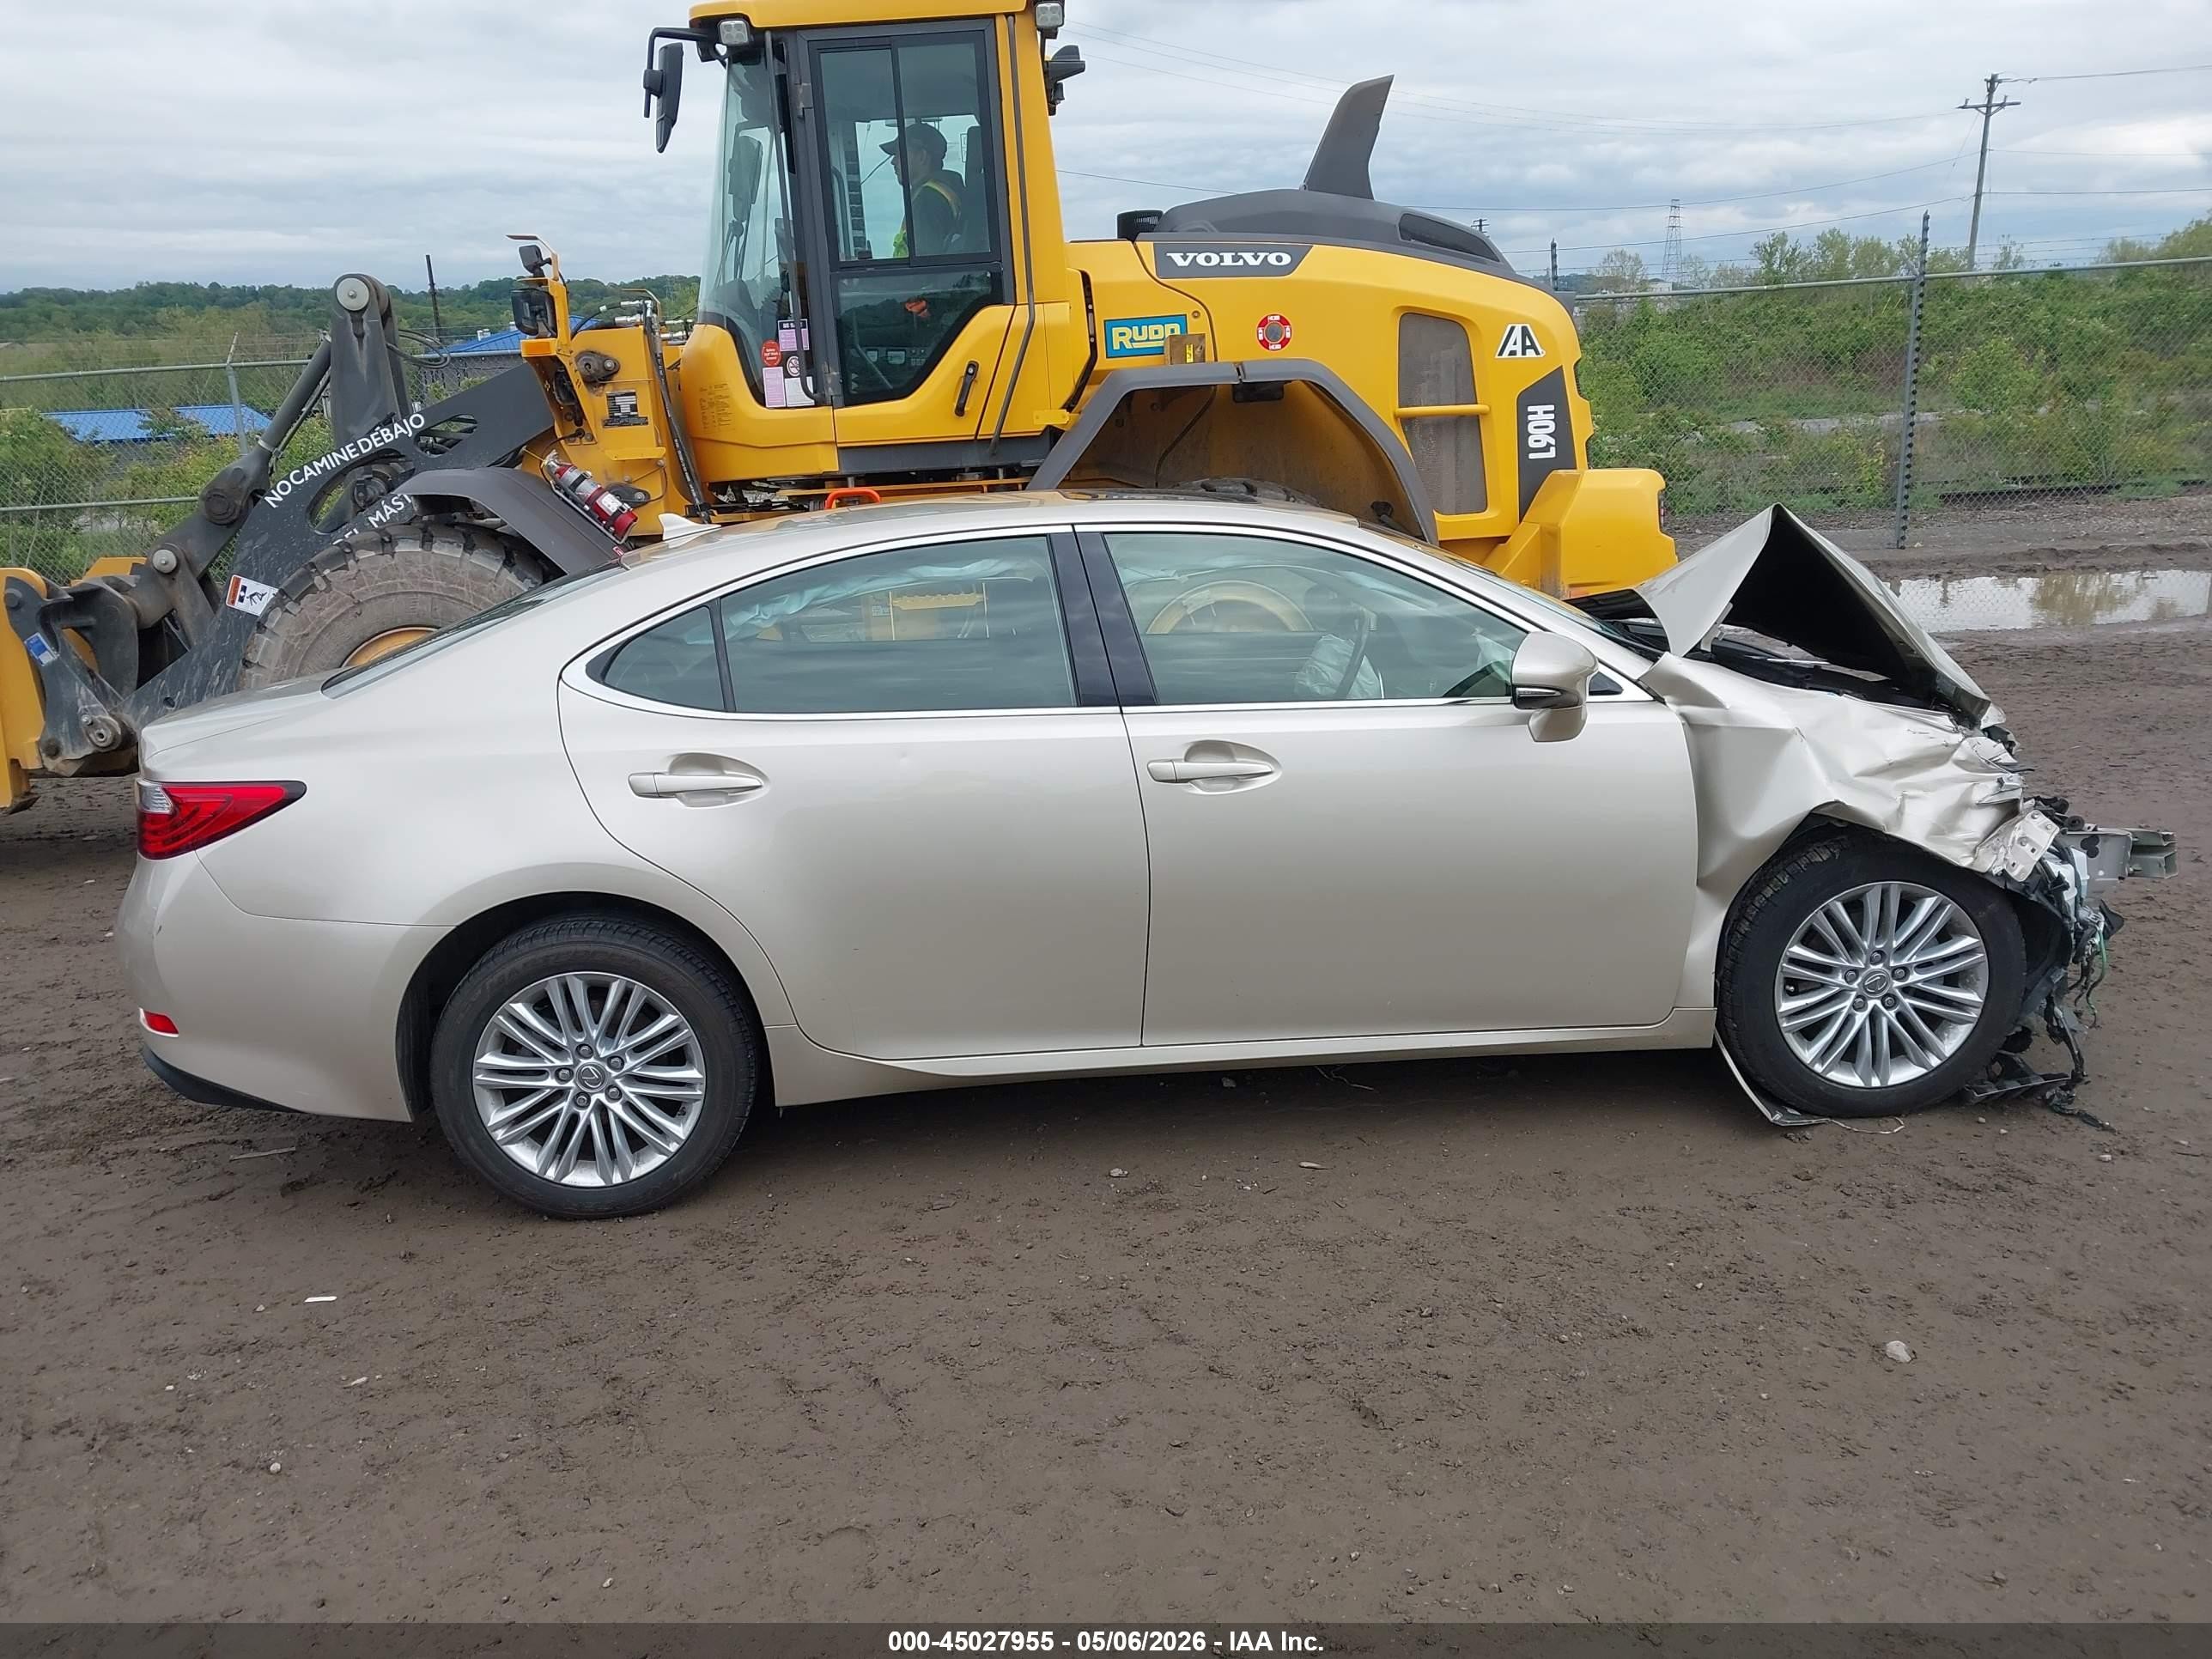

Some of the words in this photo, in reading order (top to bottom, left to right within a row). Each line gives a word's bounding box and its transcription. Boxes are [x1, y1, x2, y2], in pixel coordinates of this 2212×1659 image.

[1166, 252, 1291, 267] VOLVO
[1112, 323, 1181, 350] RUDD
[1527, 404, 1556, 459] L90H
[264, 479, 292, 509] NO
[289, 442, 360, 485] CAMINE
[356, 413, 425, 454] DÉBAJO
